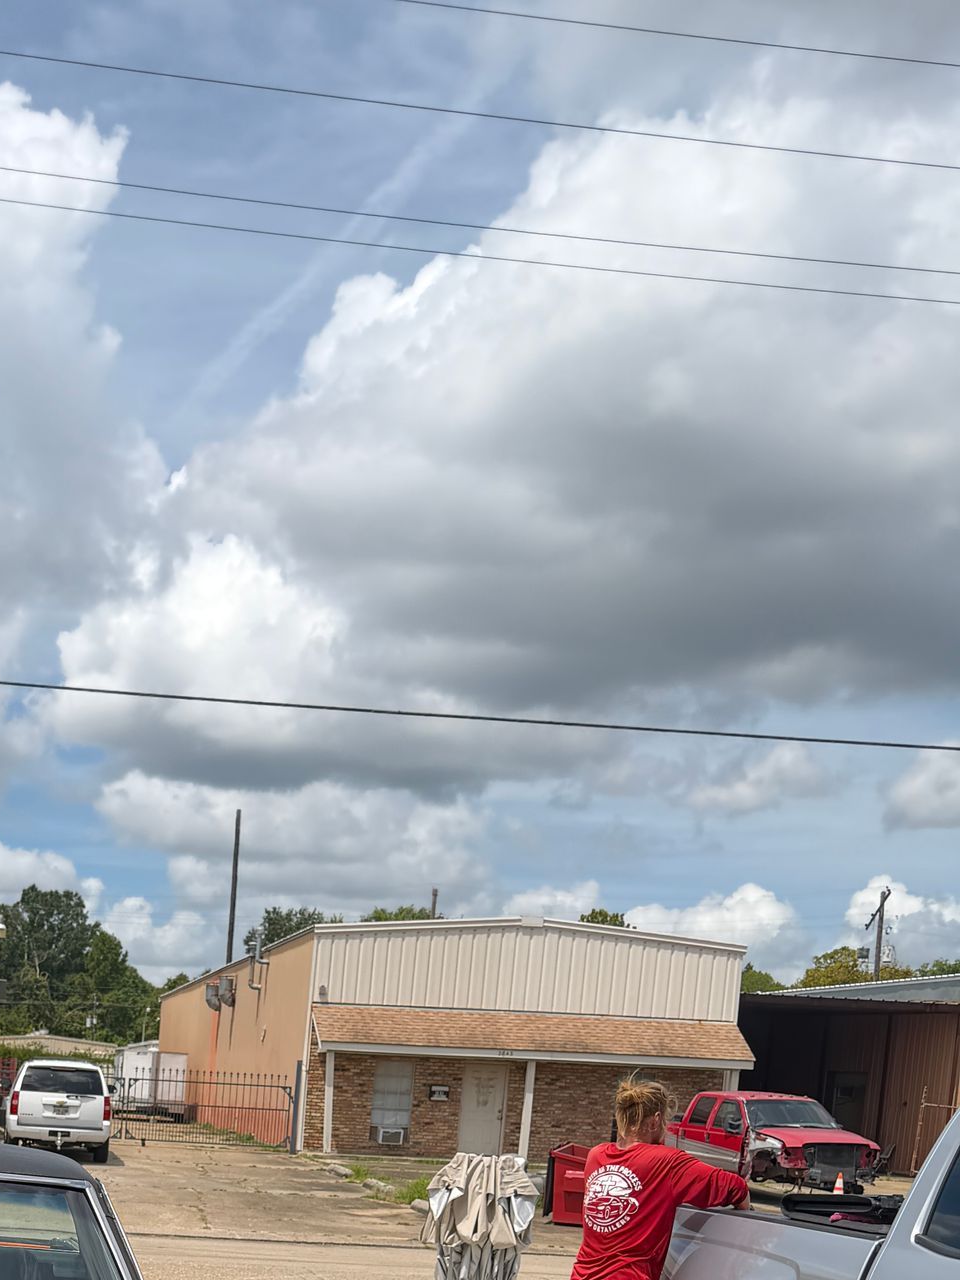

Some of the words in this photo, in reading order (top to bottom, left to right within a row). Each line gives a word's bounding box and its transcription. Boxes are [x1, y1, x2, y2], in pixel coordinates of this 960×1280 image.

[605, 1164, 619, 1172] THE
[620, 1165, 643, 1190] PROCESS
[593, 1216, 631, 1232] DETAILERS
